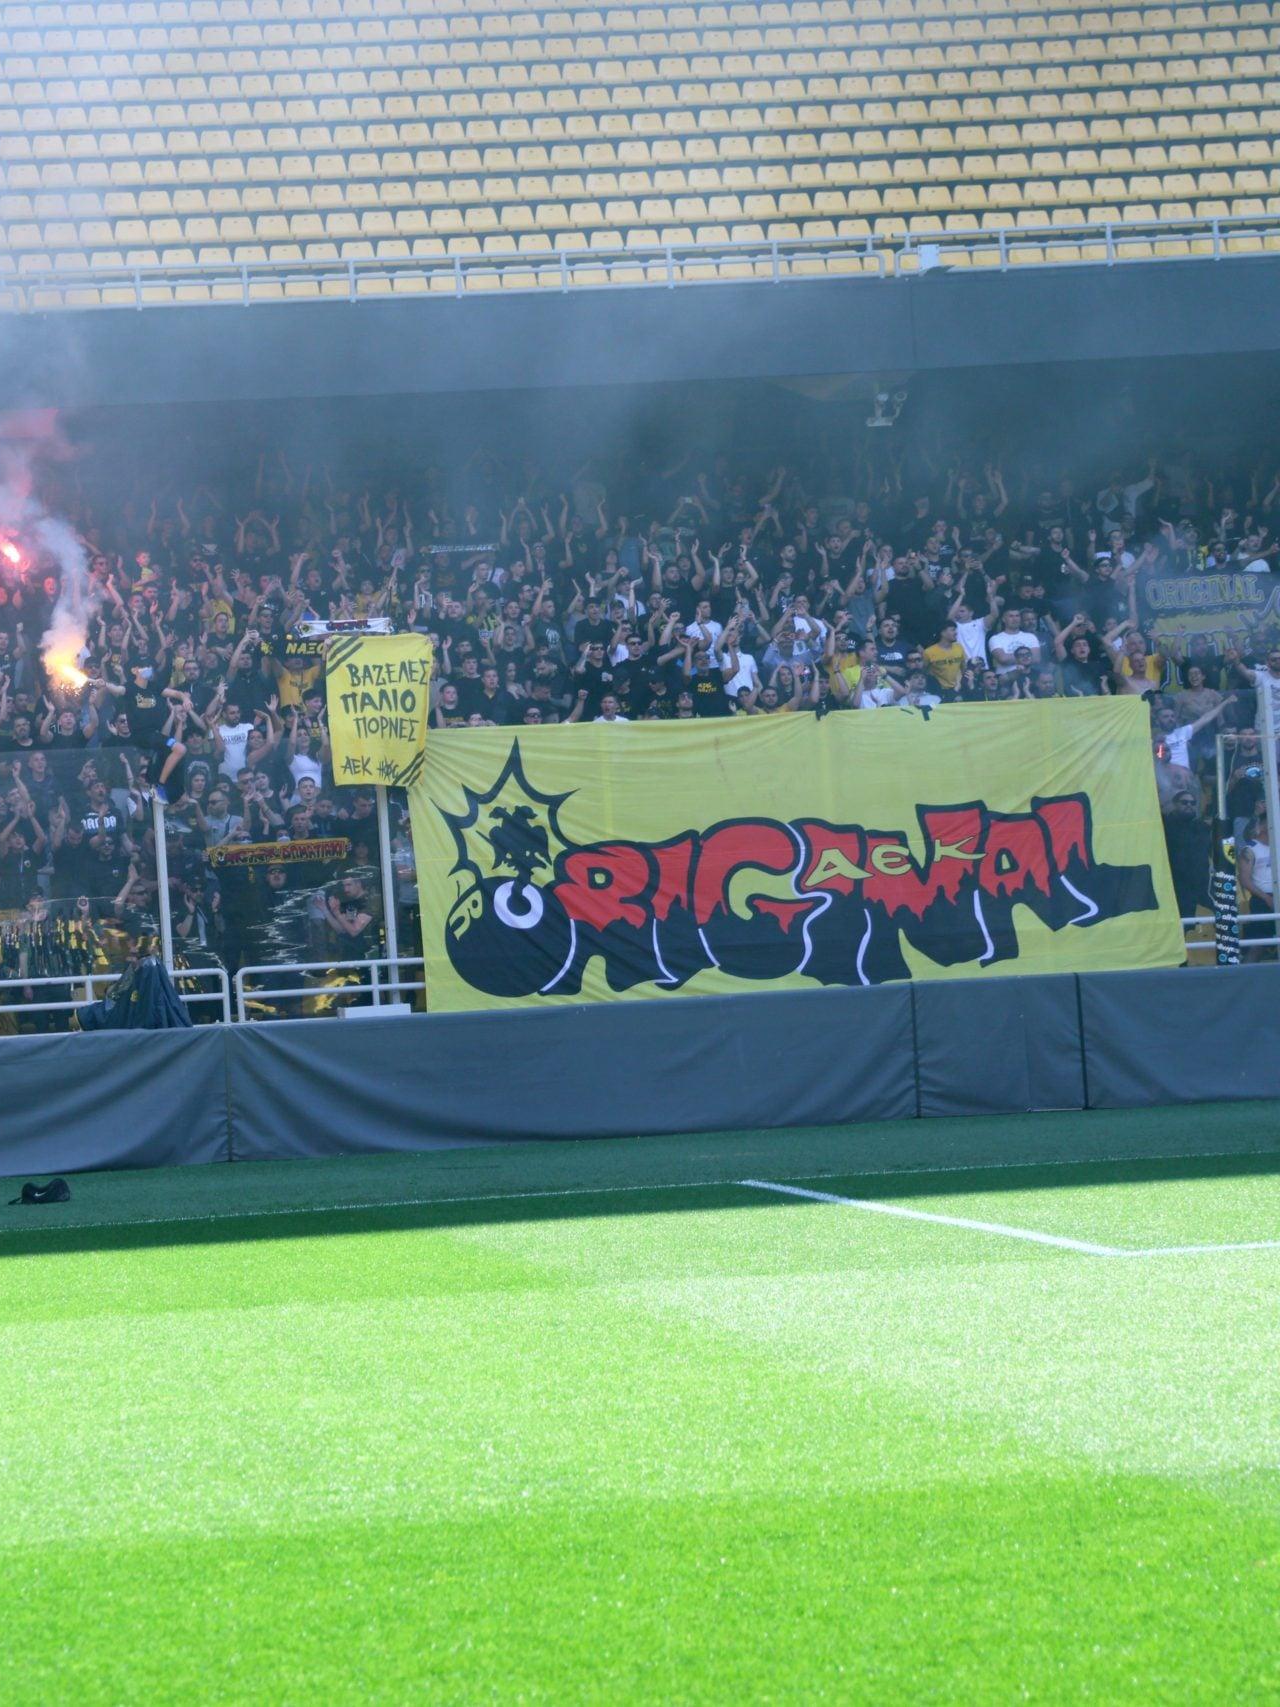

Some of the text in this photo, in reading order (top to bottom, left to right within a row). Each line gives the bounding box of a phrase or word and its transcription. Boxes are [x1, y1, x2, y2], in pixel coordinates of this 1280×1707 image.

[286, 641, 325, 655] ΝΑΞΟ
[346, 659, 431, 686] ΒΑΖΕΛΕΣ
[340, 689, 417, 714] ΠΑΛΙΟ
[353, 716, 420, 743] ΠΟΡΝΕΣ
